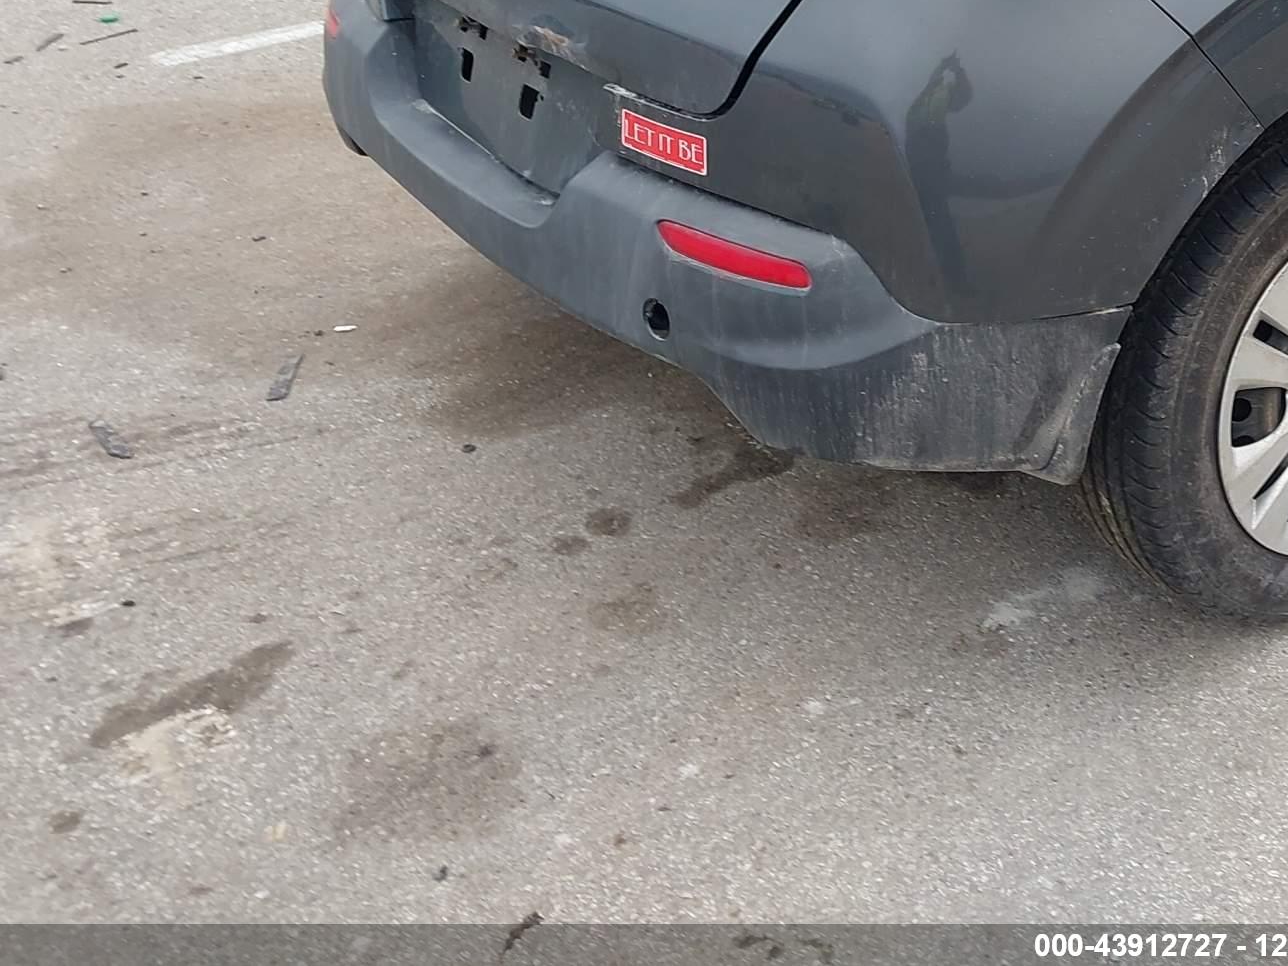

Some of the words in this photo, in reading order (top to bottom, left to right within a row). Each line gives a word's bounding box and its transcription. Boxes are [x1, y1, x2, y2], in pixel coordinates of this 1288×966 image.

[624, 119, 656, 147] LET
[658, 133, 675, 155] IT
[678, 138, 704, 165] BE
